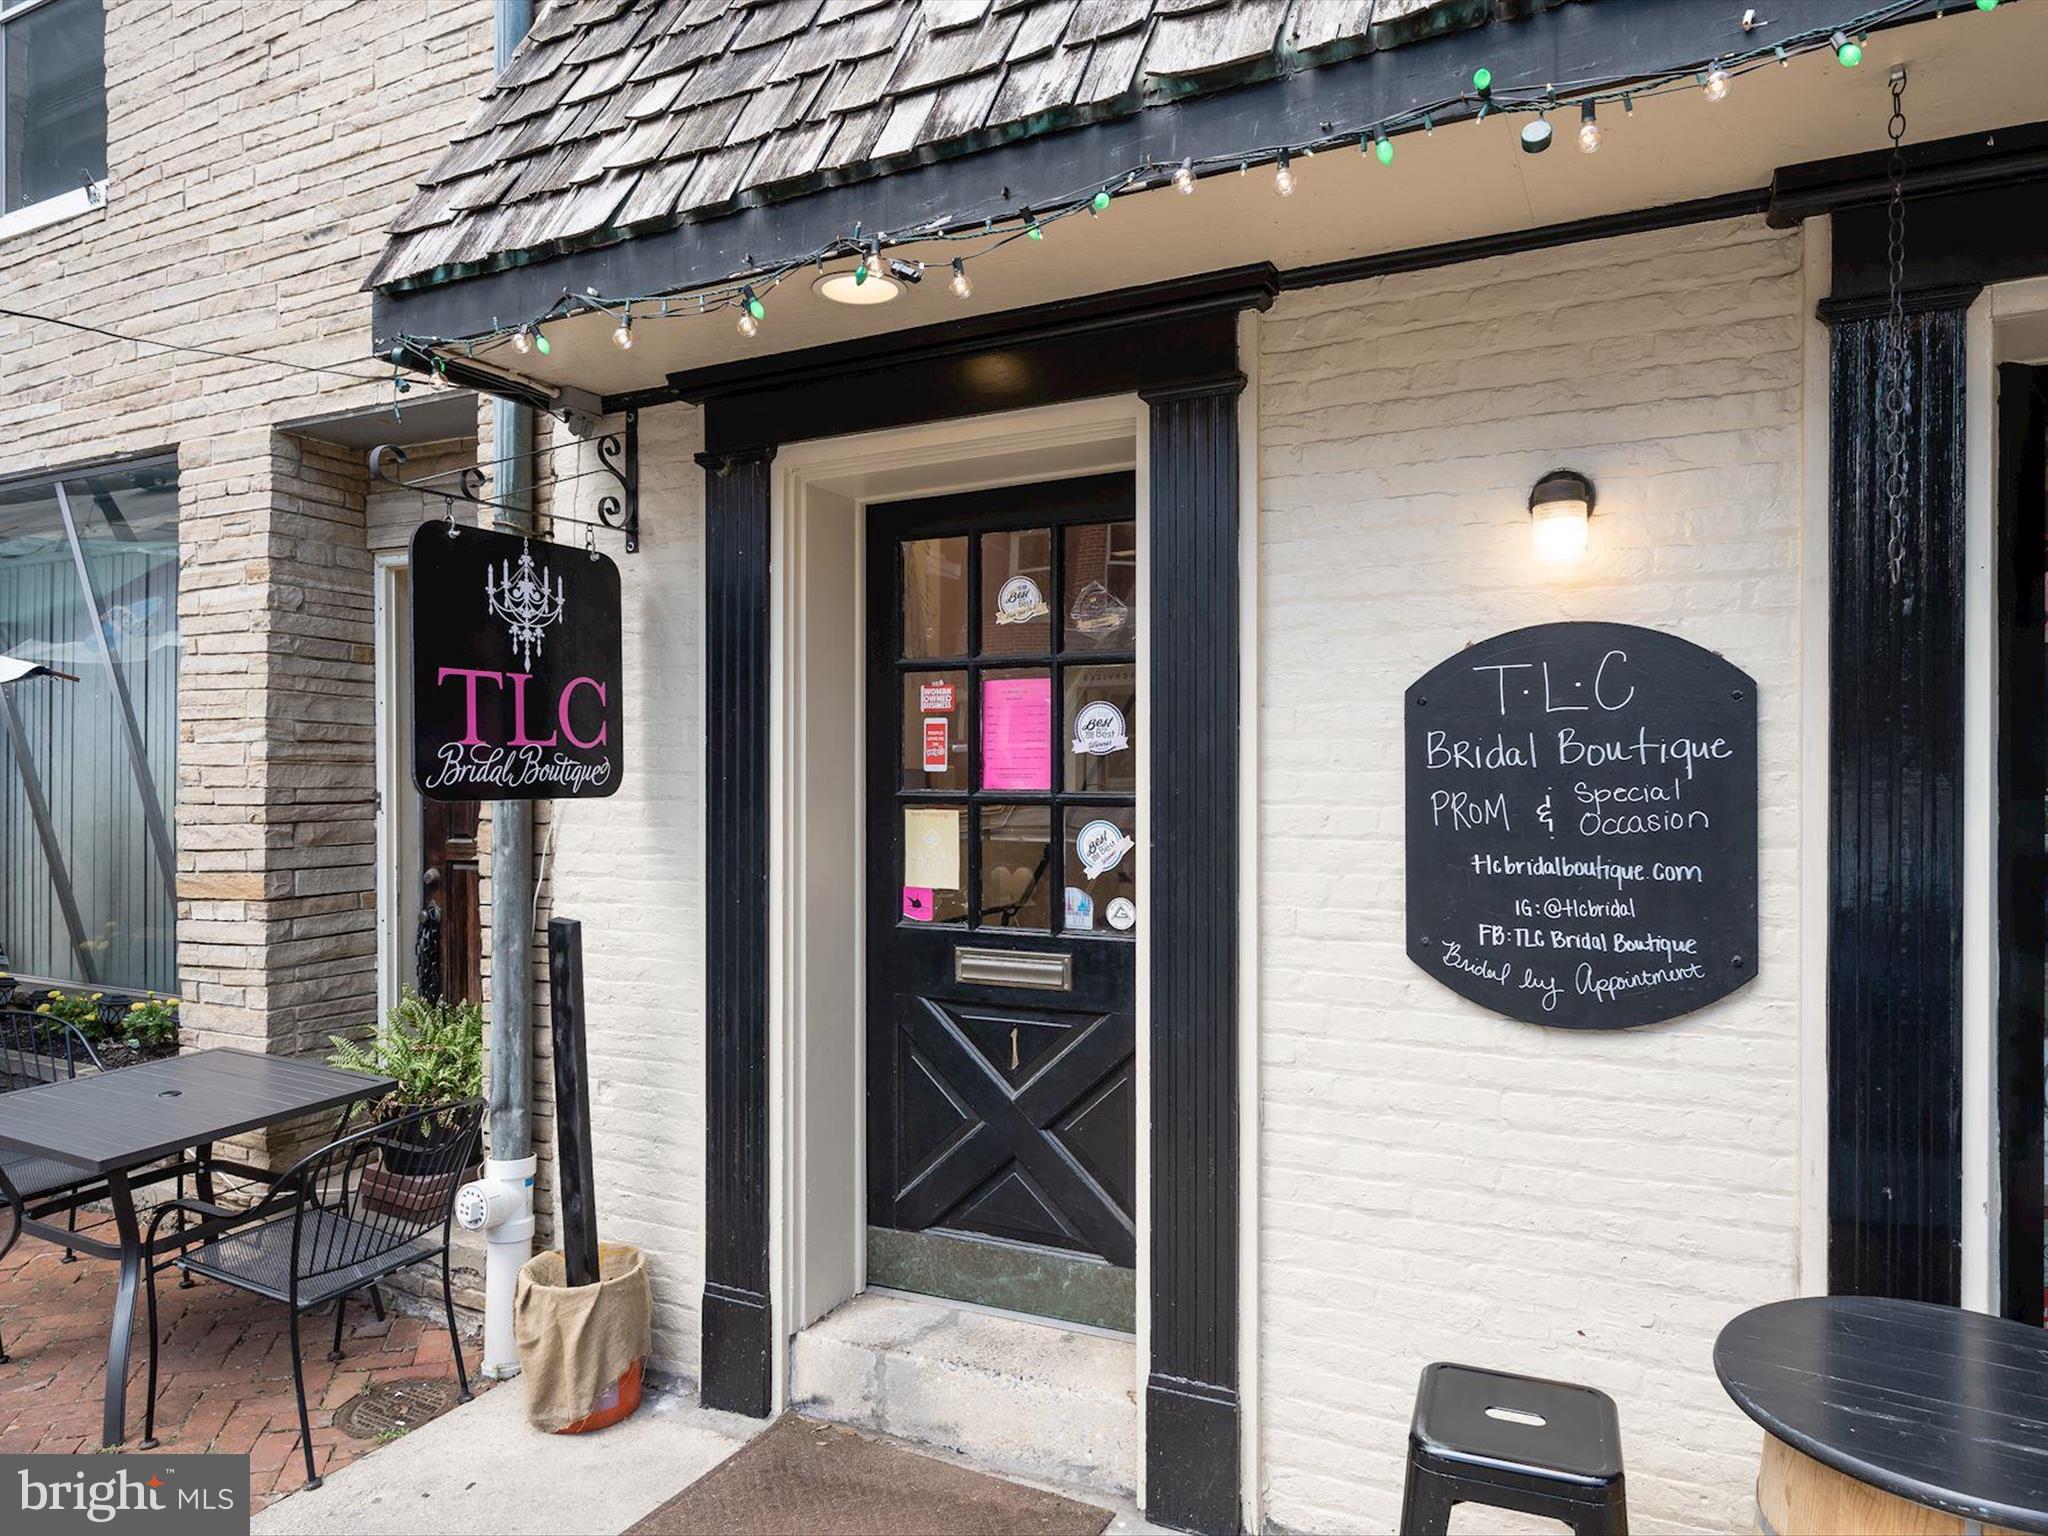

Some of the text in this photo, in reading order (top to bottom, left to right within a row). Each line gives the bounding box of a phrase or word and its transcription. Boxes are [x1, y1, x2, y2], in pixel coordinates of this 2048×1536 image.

[437, 667, 608, 750] TLC
[1081, 716, 1114, 731] Best
[425, 741, 611, 794] Bridal Boutique
[1557, 726, 1734, 780] Boutique
[1573, 777, 1683, 814] Special
[1579, 810, 1709, 837] Occasion
[1470, 853, 1703, 891] tlcbridalboutique.com
[1550, 930, 1608, 952] Bridal
[1613, 932, 1698, 964] Boutique
[1440, 939, 1706, 1011] Bridal by Appointment
[1010, 1027, 1020, 1071] 1
